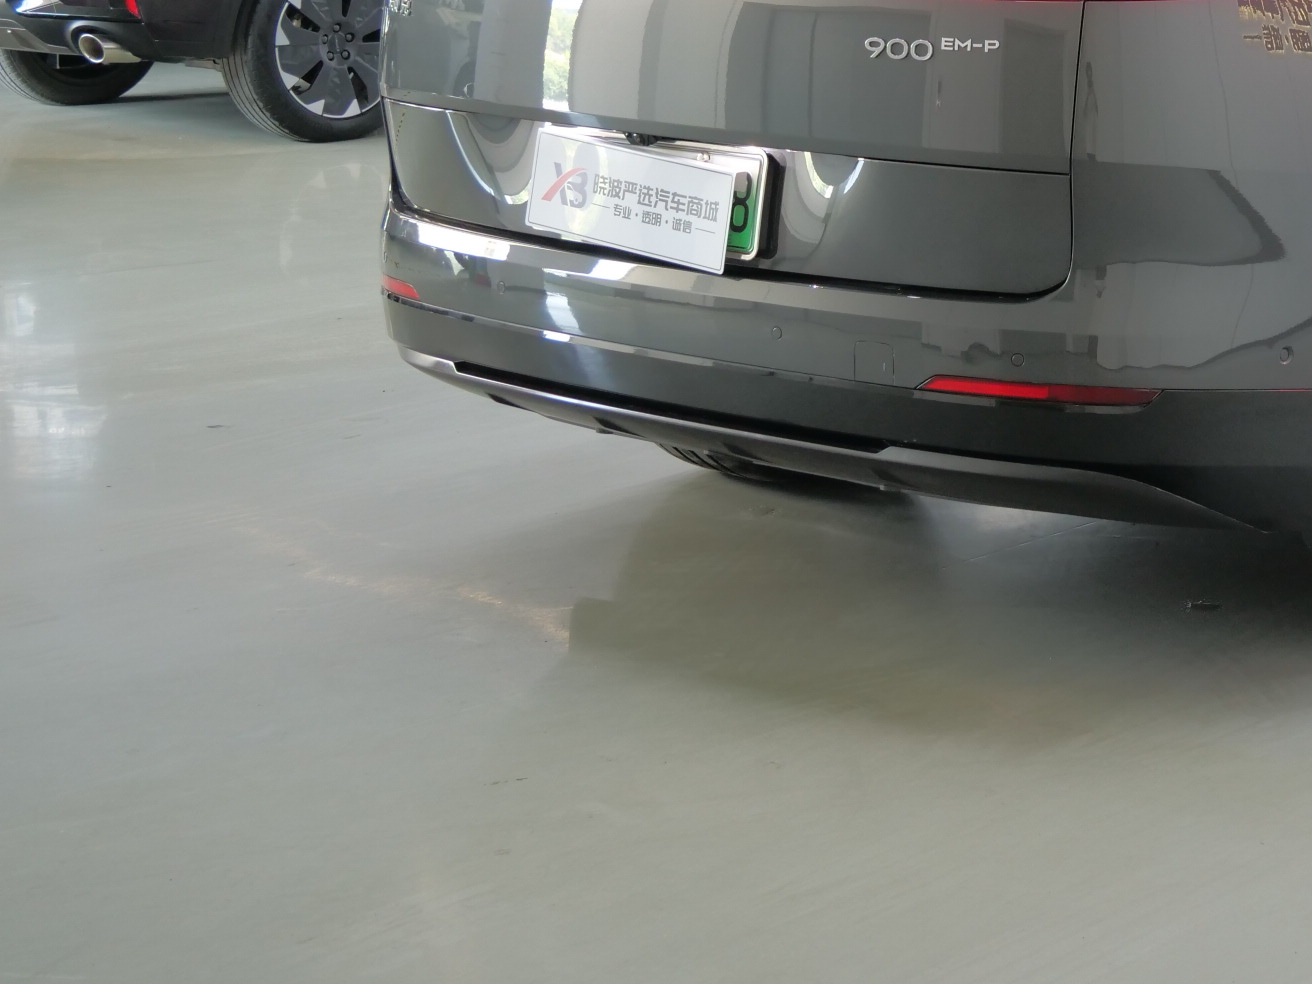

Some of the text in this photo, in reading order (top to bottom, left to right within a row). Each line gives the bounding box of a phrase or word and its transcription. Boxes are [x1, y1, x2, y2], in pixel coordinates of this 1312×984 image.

[864, 36, 1000, 61] 900 EM-P
[592, 174, 720, 223] 晓波严选汽车商城
